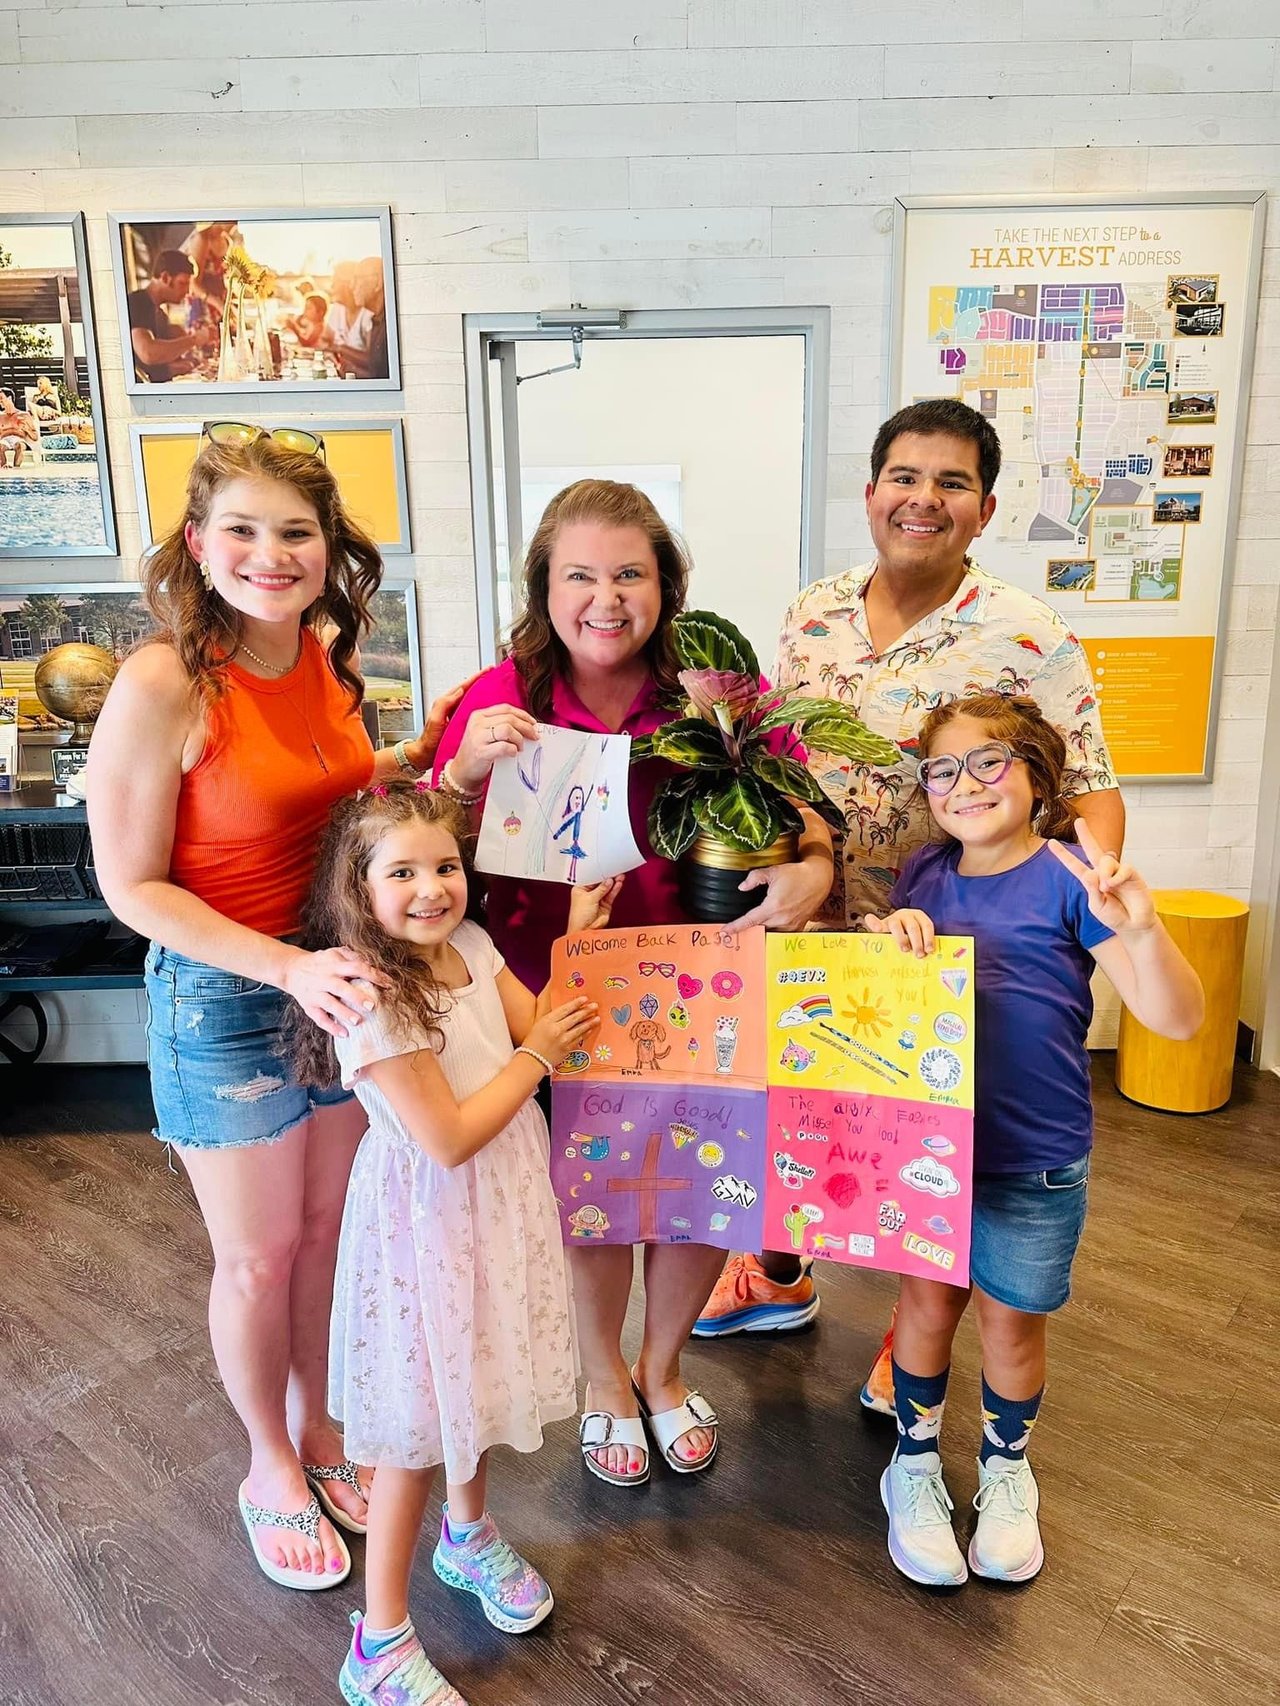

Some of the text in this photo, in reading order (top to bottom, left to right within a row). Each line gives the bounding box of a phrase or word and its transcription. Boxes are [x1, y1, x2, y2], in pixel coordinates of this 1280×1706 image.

[994, 226, 1162, 244] TAKE THE NEXT STEP to a
[969, 246, 1182, 268] HARVEST ADDRESS
[566, 937, 627, 958] Welcome
[636, 932, 678, 948] Back
[784, 936, 807, 952] We
[583, 1094, 625, 1117] God
[673, 1099, 734, 1130] Good!
[788, 1094, 815, 1112] The
[879, 1203, 907, 1223] FAR
[878, 1216, 903, 1232] OUT
[904, 1233, 954, 1267] LOVE
